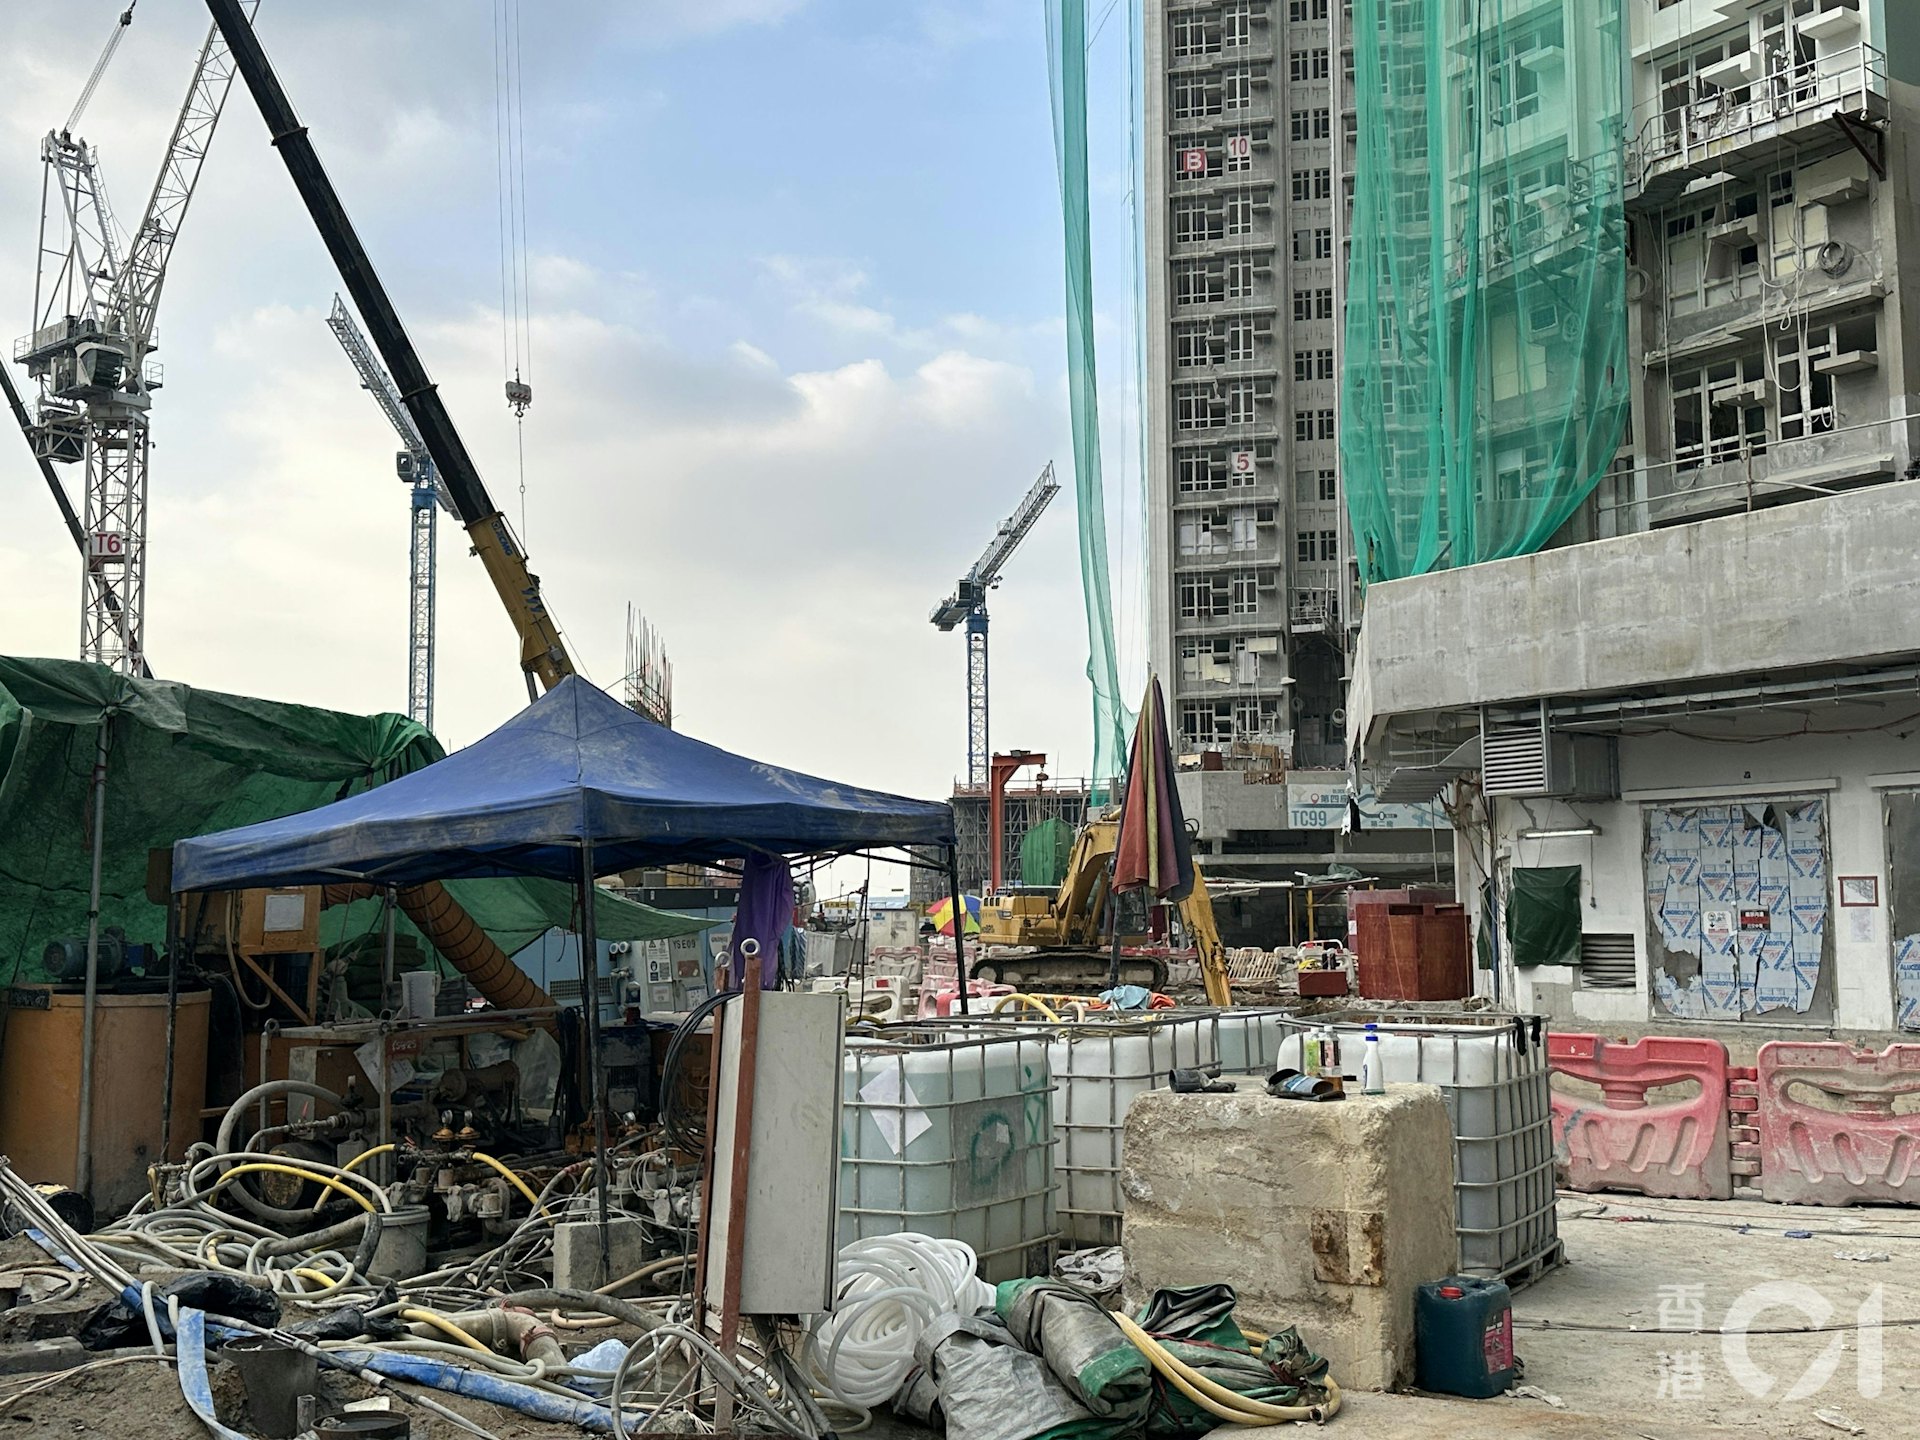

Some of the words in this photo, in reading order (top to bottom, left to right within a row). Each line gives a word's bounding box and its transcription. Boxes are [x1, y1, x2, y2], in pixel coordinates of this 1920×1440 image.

[1230, 138, 1248, 156] 10
[1186, 151, 1203, 170] B
[1236, 453, 1249, 471] 5
[94, 533, 122, 553] T6
[1291, 810, 1327, 827] TC99
[673, 939, 697, 950] YSE09
